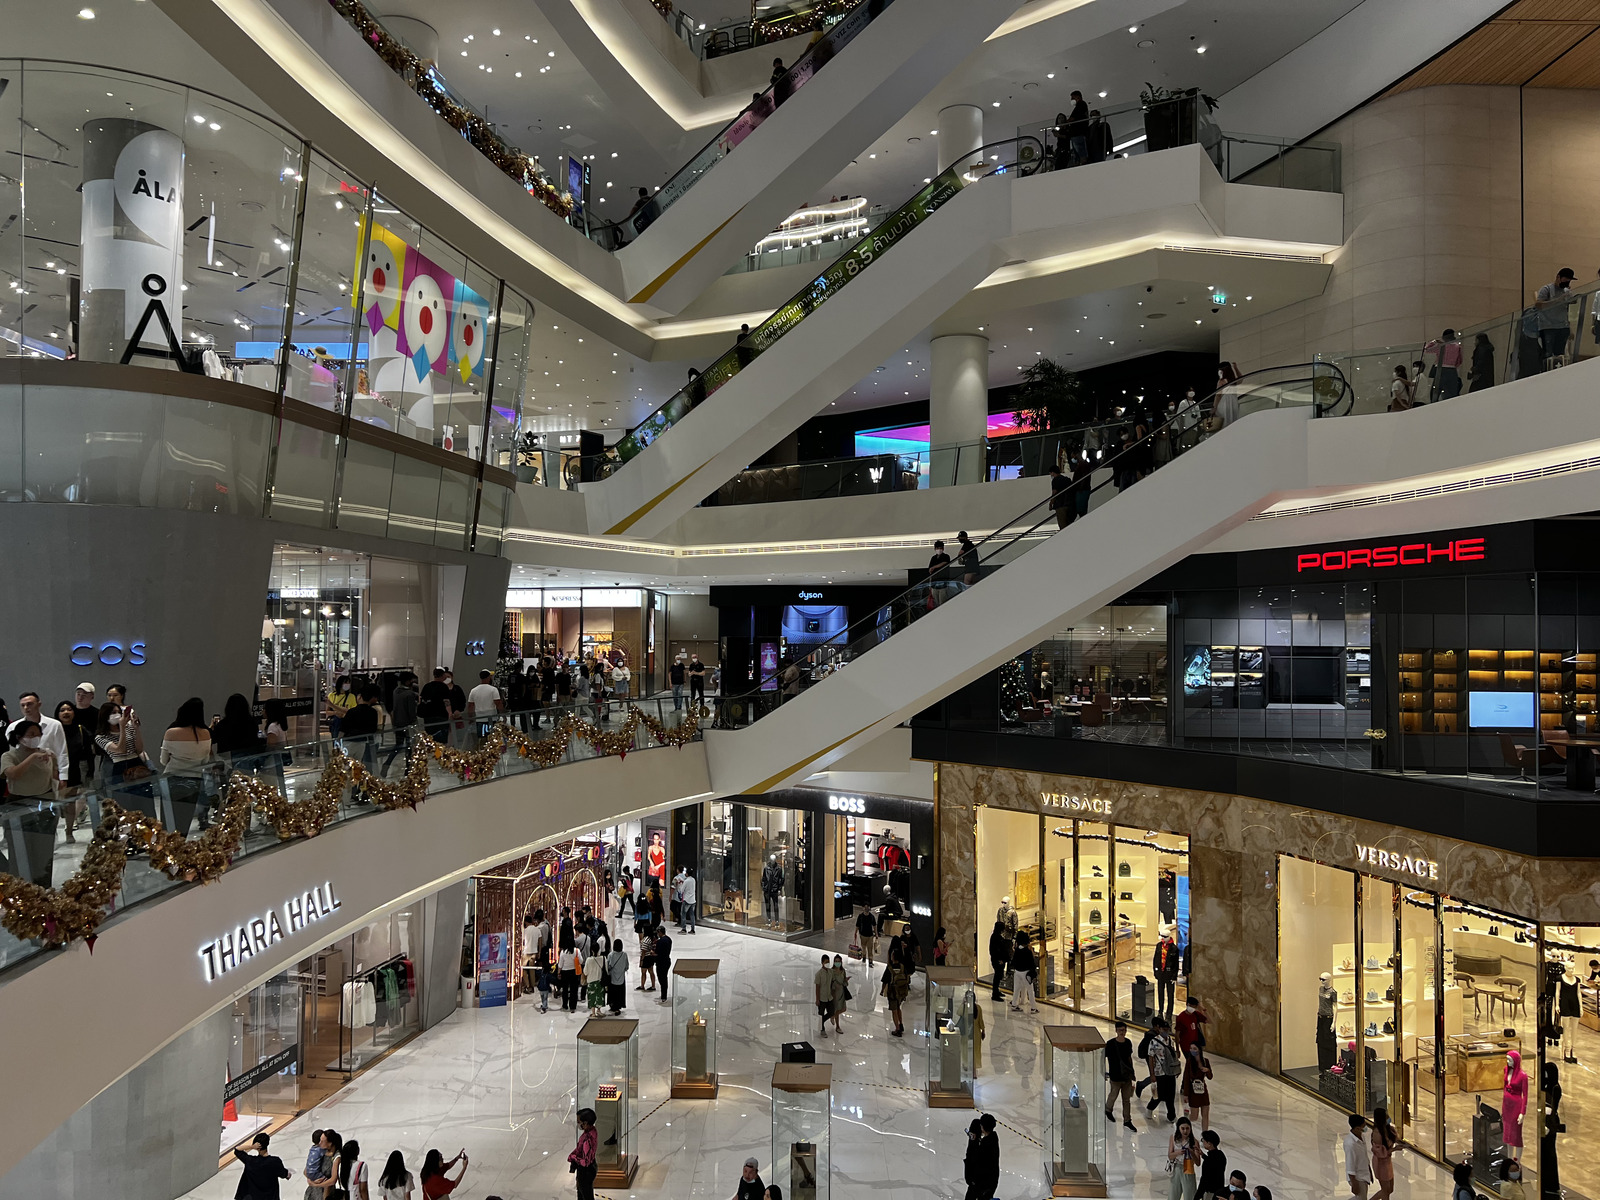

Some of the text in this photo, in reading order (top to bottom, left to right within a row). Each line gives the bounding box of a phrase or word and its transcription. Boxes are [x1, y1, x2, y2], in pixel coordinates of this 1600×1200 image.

[845, 246, 874, 276] 8.5
[121, 273, 191, 372] Å
[1297, 537, 1485, 573] PORSCHE
[798, 590, 823, 601] dyson
[69, 641, 147, 667] COS
[464, 640, 485, 656] COS
[829, 795, 865, 814] BOSS
[1040, 792, 1113, 815] VERSACE
[1355, 843, 1439, 881] VERSACE
[912, 905, 932, 917] BOSS
[200, 880, 342, 983] THARA HALL
